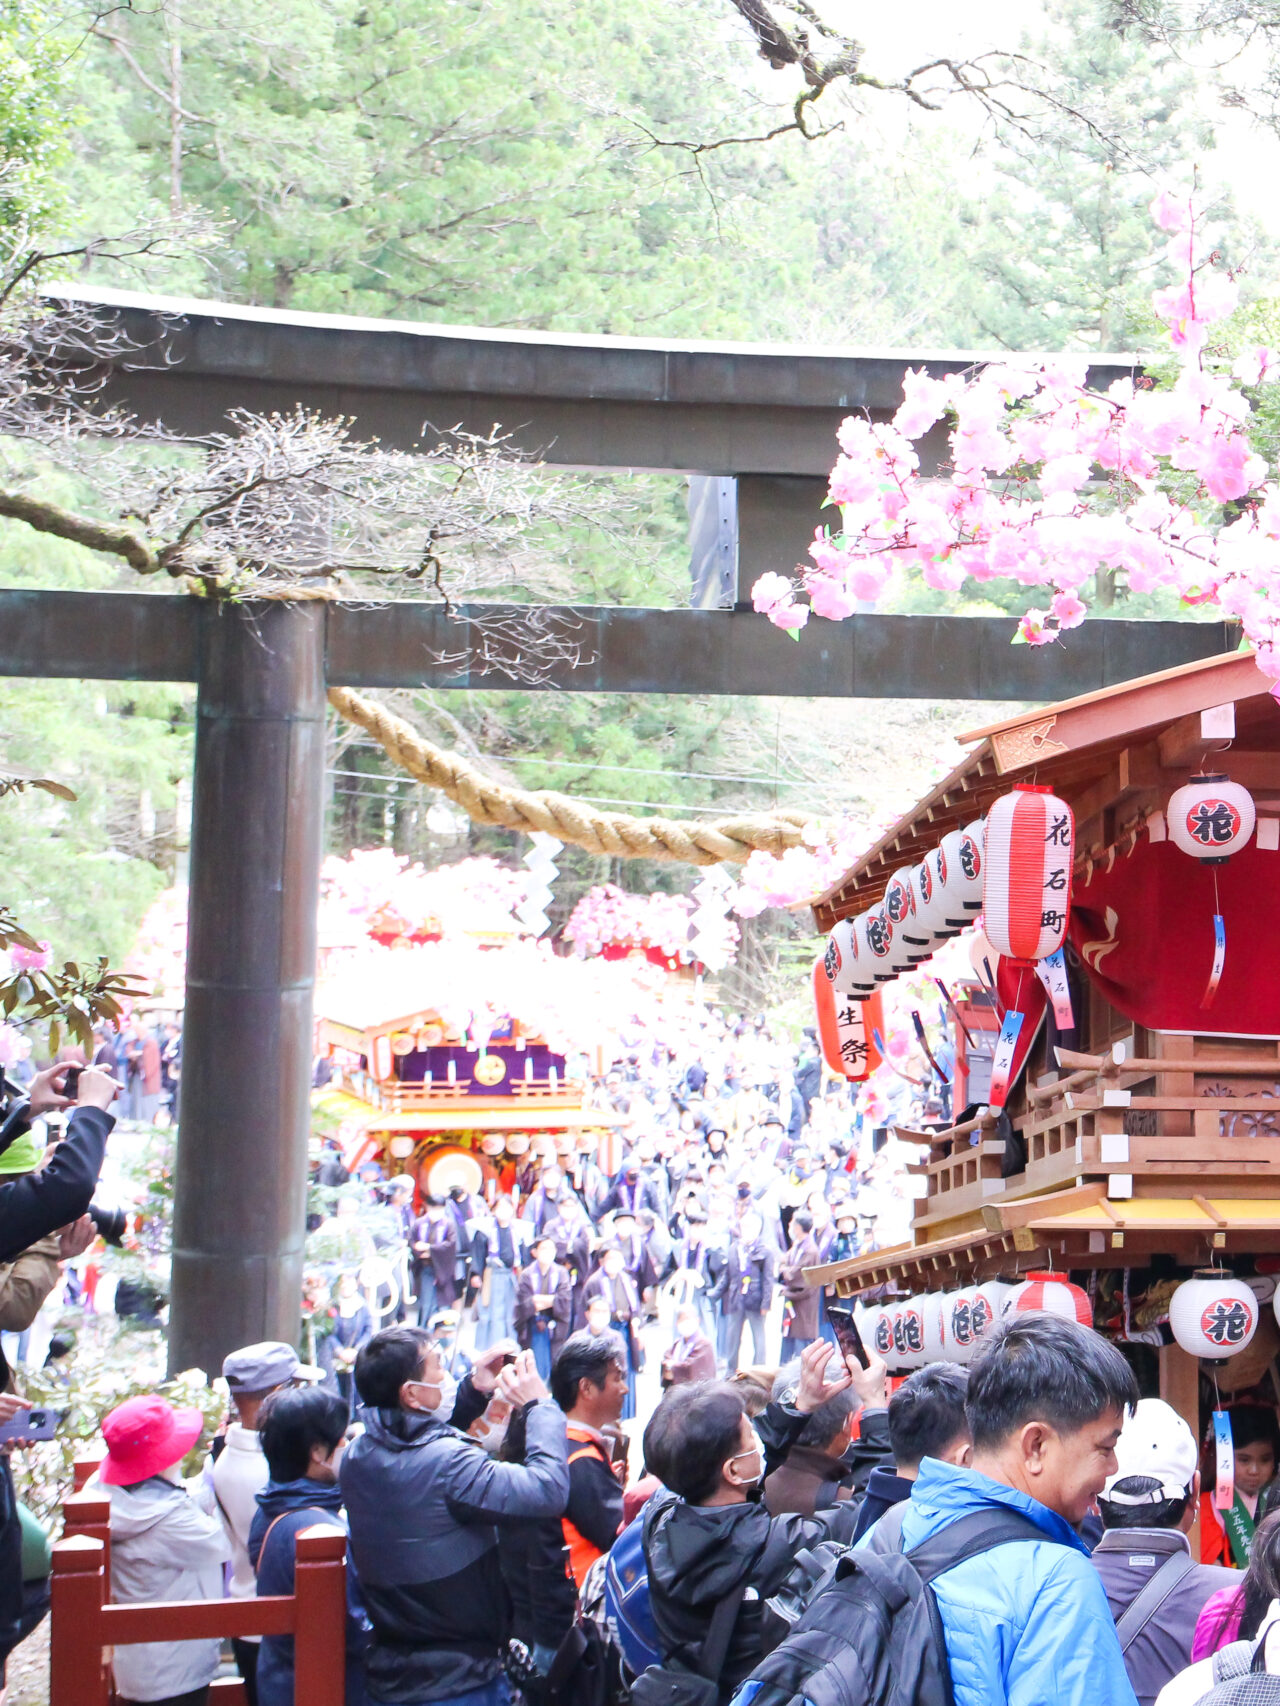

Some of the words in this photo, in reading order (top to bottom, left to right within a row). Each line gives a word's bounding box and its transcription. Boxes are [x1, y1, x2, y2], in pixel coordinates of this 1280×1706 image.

[1191, 804, 1235, 842] 花
[1041, 814, 1071, 934] 花石町
[838, 1007, 871, 1064] 生祭
[1206, 1302, 1248, 1342] 花
